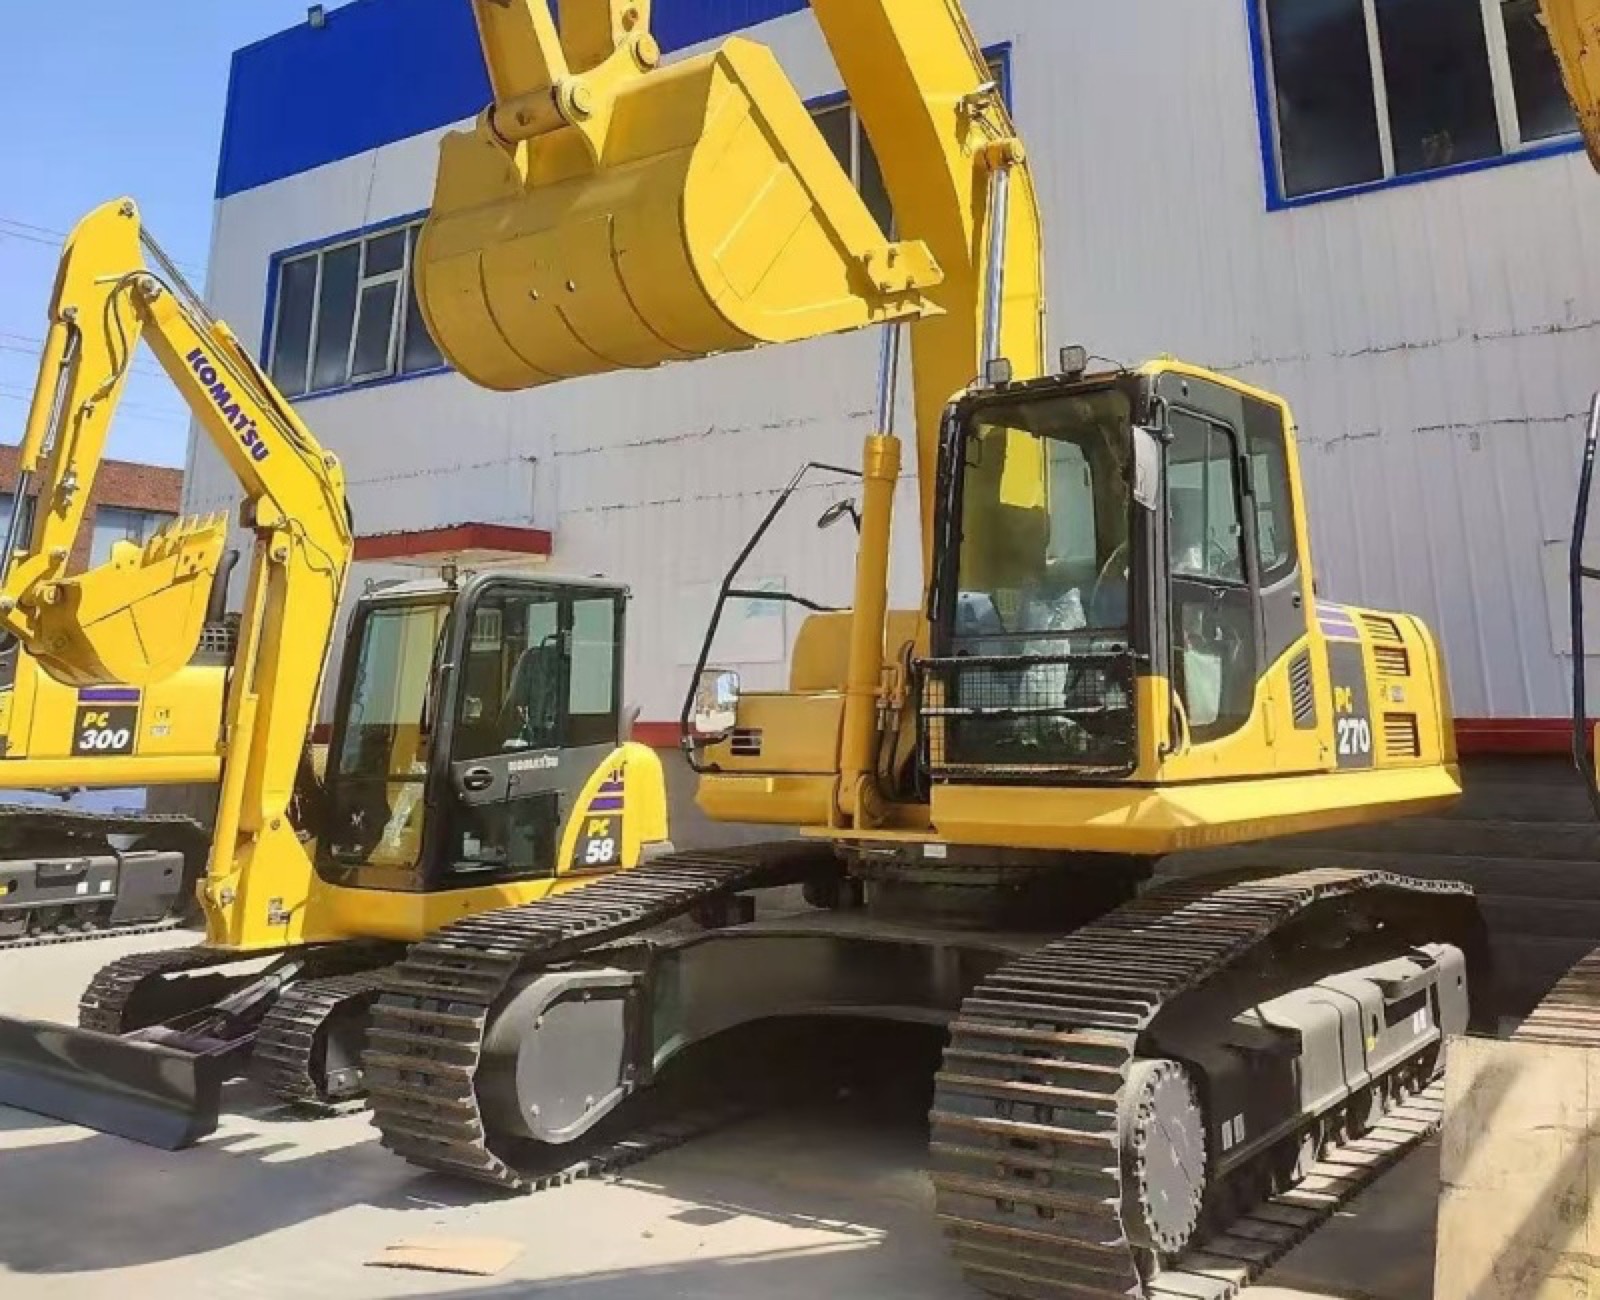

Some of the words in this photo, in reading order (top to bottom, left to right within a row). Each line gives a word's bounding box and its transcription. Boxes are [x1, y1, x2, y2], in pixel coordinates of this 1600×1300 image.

[186, 347, 269, 462] KOMATSU
[82, 711, 110, 728] PC
[79, 729, 130, 750] 300
[1337, 717, 1371, 755] 270
[585, 838, 614, 864] 58
